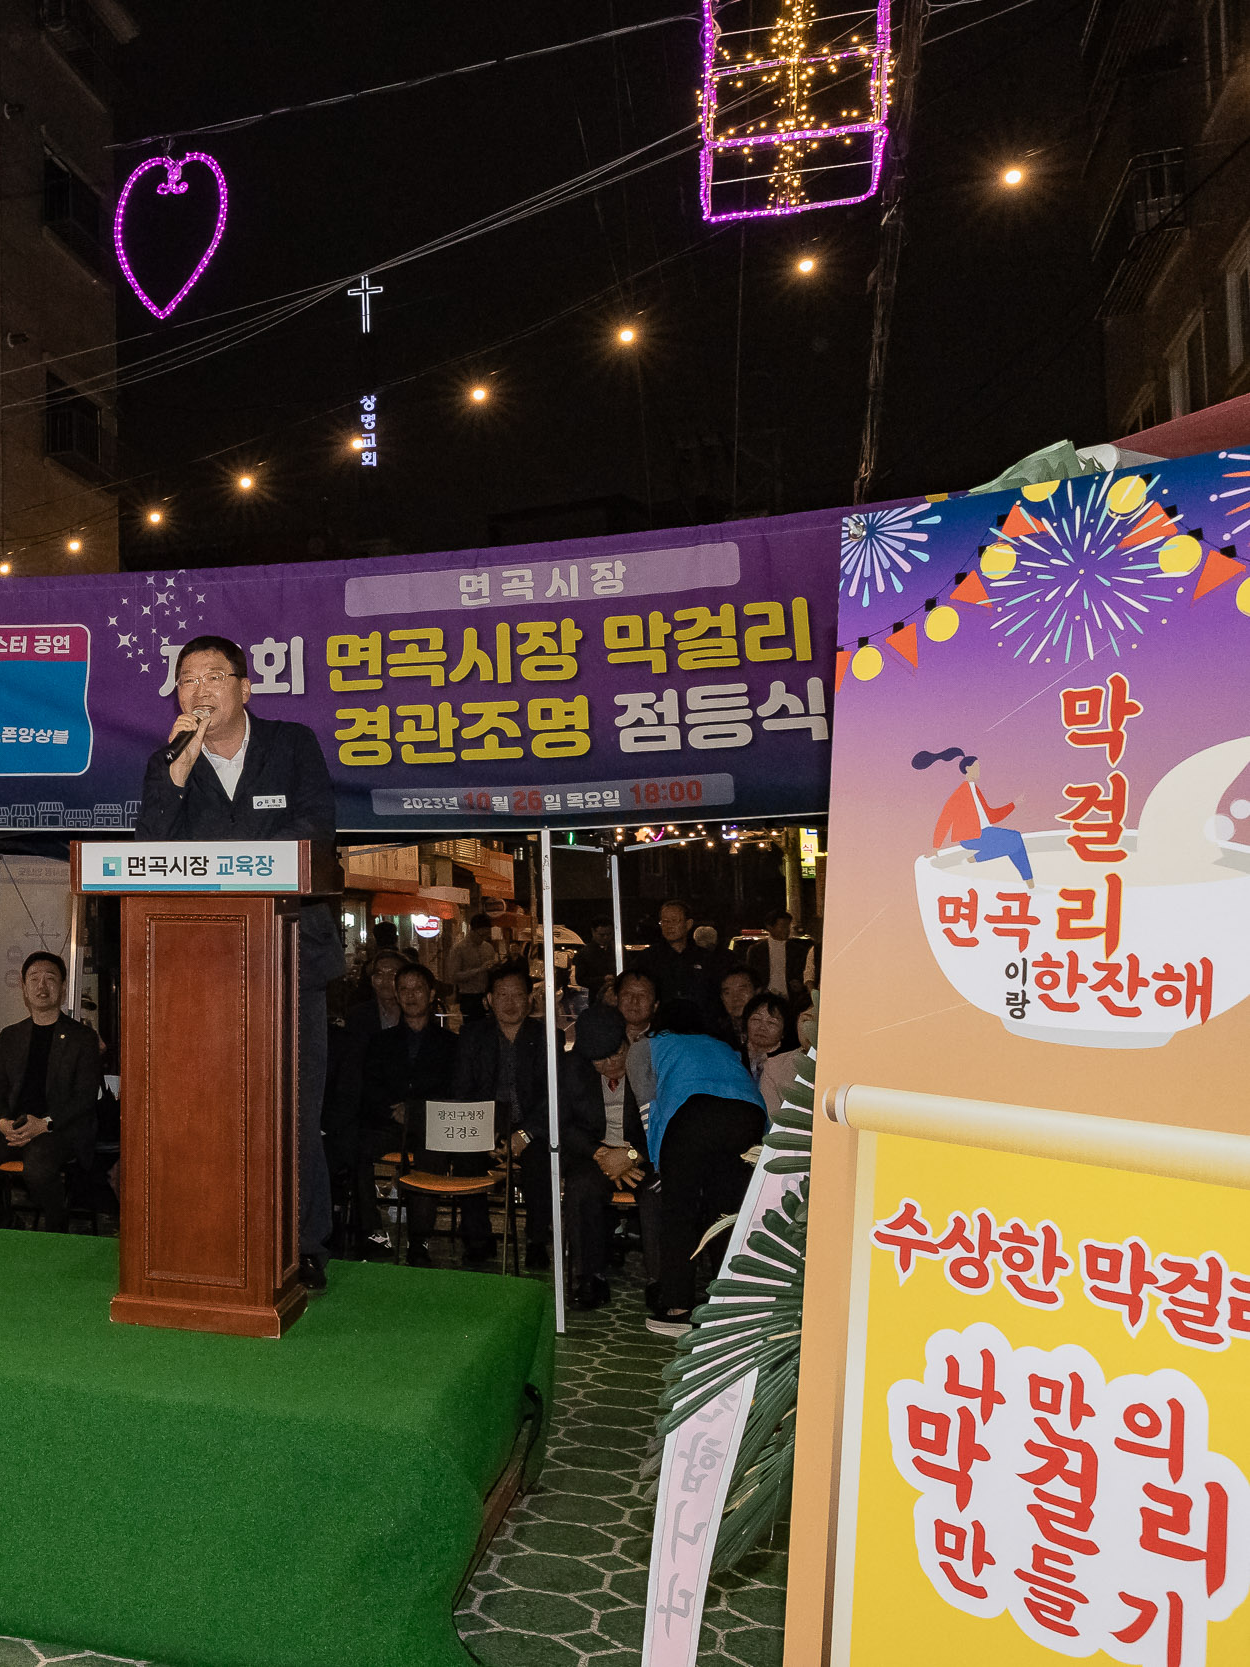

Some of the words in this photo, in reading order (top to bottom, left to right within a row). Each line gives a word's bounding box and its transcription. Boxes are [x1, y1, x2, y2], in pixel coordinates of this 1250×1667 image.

[459, 561, 626, 606] 면곡시장
[33, 634, 71, 654] 공연
[326, 617, 584, 693] 면곡시장
[603, 596, 813, 675] 막걸리
[334, 694, 591, 767] 경관조명
[614, 676, 830, 754] 점등식
[401, 796, 460, 811] 2023년
[512, 789, 562, 812] 26일
[566, 789, 621, 808] 목요일
[629, 779, 703, 806] 18:00
[1055, 672, 1144, 962] 막걸리
[127, 855, 210, 877] 면곡시장
[215, 855, 275, 877] 교육장
[937, 887, 1041, 953] 면곡
[1005, 956, 1031, 1020] 이랑
[1032, 950, 1214, 1026] 한잔해
[437, 1109, 486, 1122] 광진구청장
[443, 1125, 481, 1140] 김경호
[873, 1201, 1069, 1306] 수상한
[906, 1404, 1230, 1598] 막걸리
